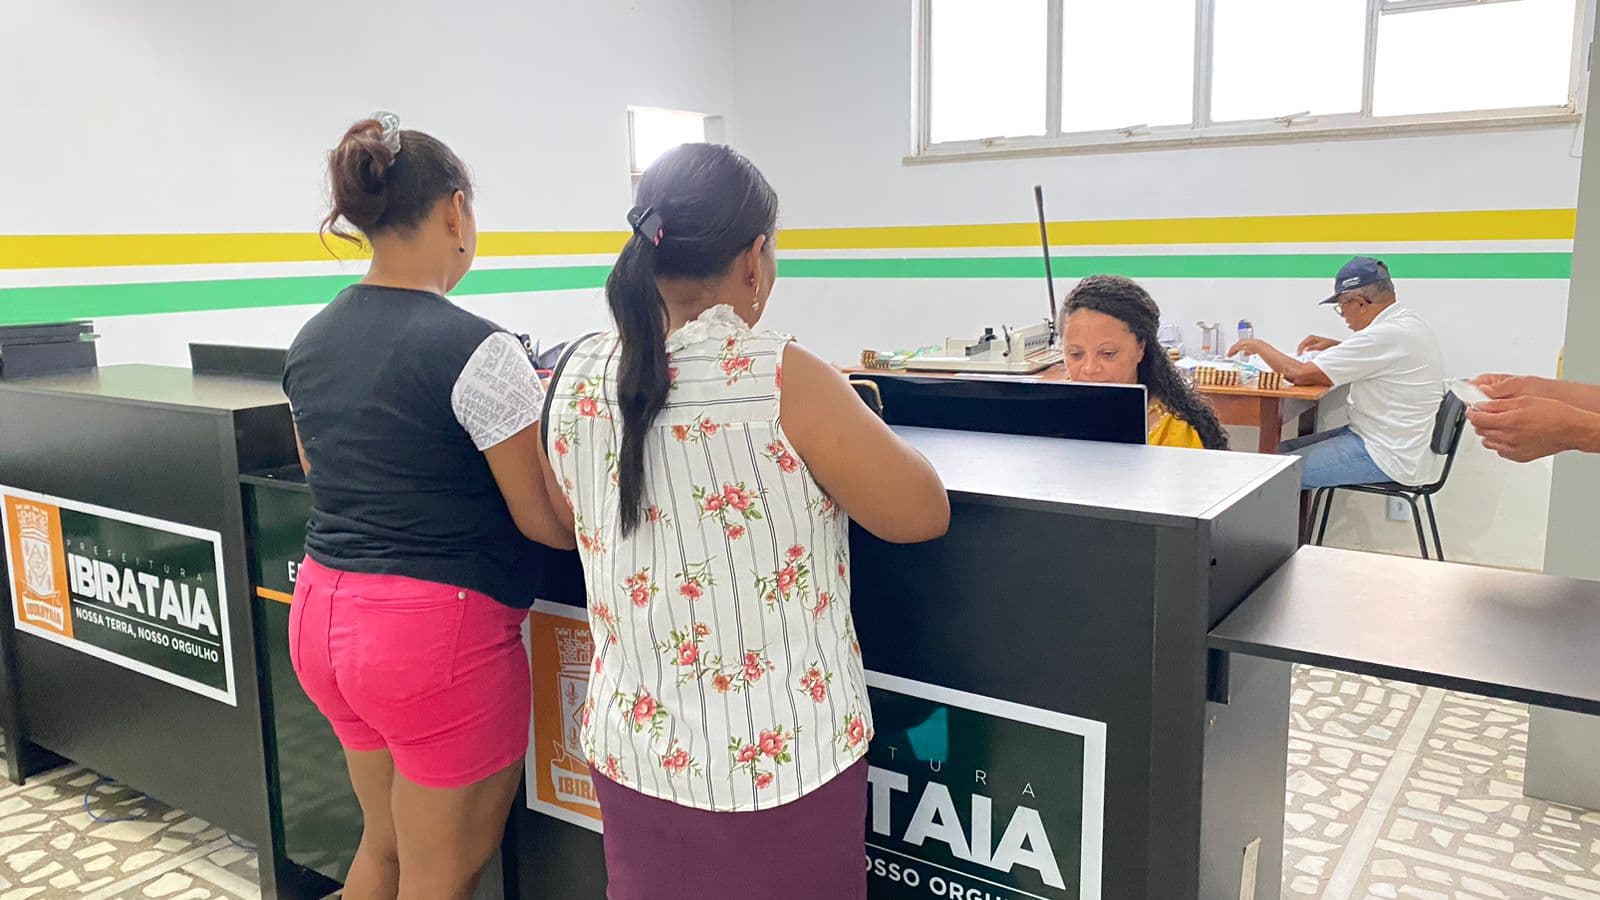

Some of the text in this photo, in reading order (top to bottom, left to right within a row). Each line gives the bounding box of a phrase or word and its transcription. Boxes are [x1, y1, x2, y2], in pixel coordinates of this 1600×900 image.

[66, 538, 203, 582] PREFEITURA
[67, 552, 219, 636] IBIRATAIA
[75, 606, 219, 663] NOSSA TERRA, NOSSO ORGULHO
[558, 776, 597, 801] IBIR
[867, 765, 1067, 891] TAIA
